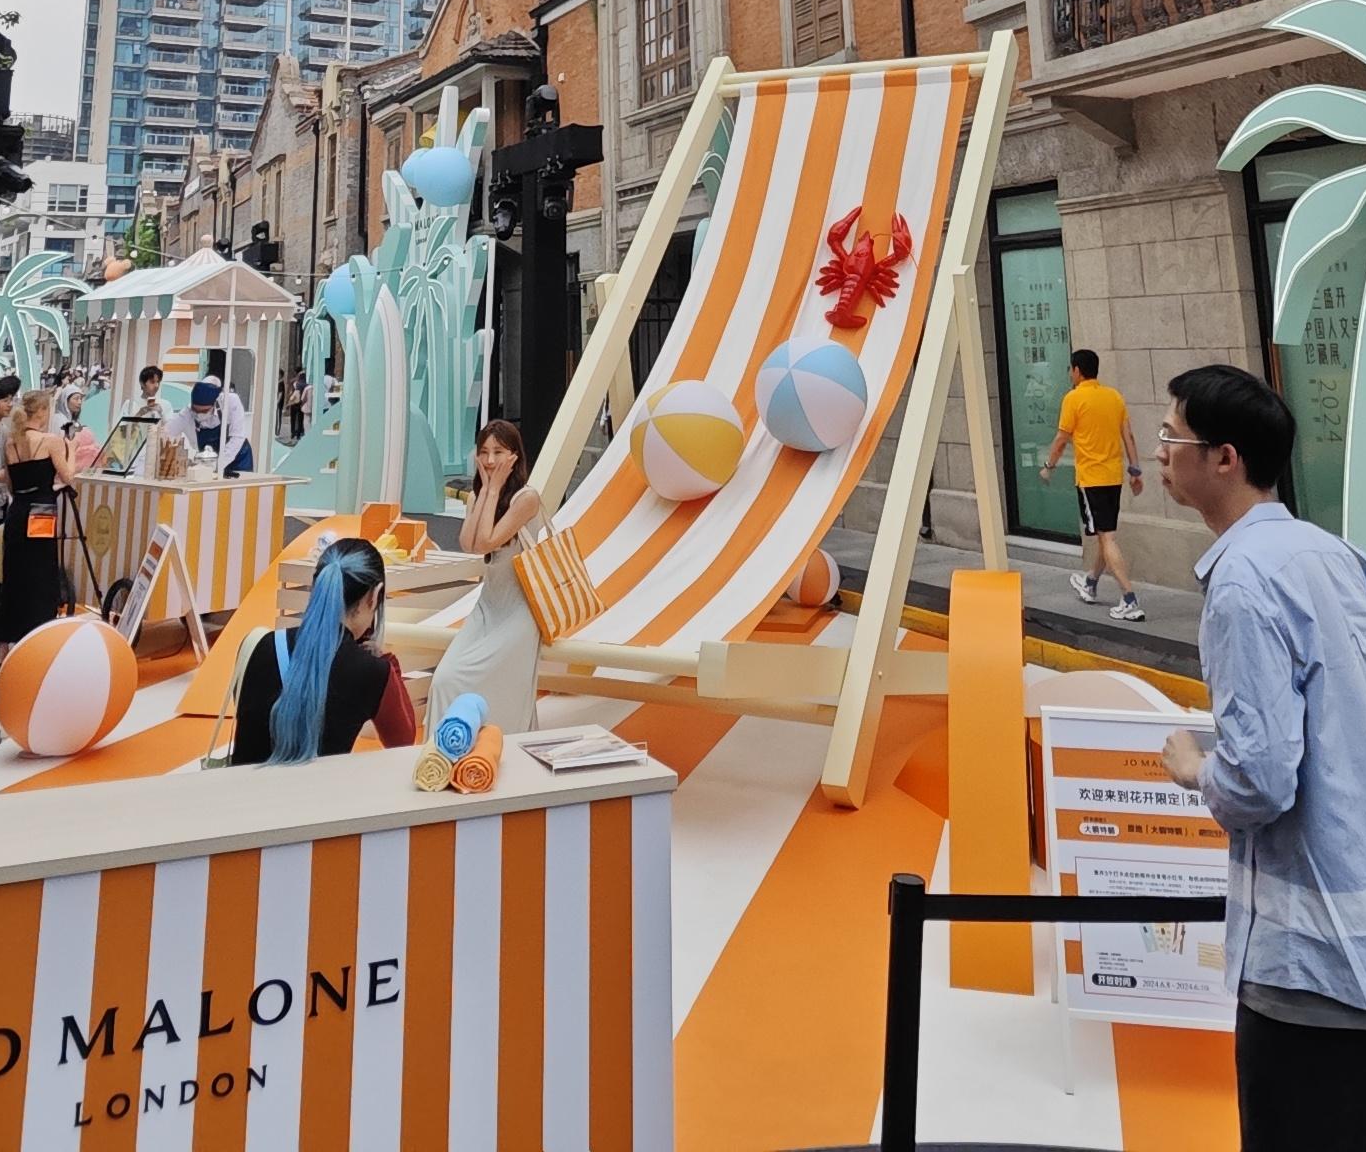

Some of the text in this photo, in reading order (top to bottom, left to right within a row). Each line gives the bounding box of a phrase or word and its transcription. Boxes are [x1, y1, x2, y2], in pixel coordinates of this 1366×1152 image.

[1305, 318, 1360, 339] 中国人文与
[1319, 379, 1343, 442] 2024
[1123, 759, 1137, 767] JO
[57, 958, 400, 1066] MALONE
[74, 1064, 268, 1127] LONDON
